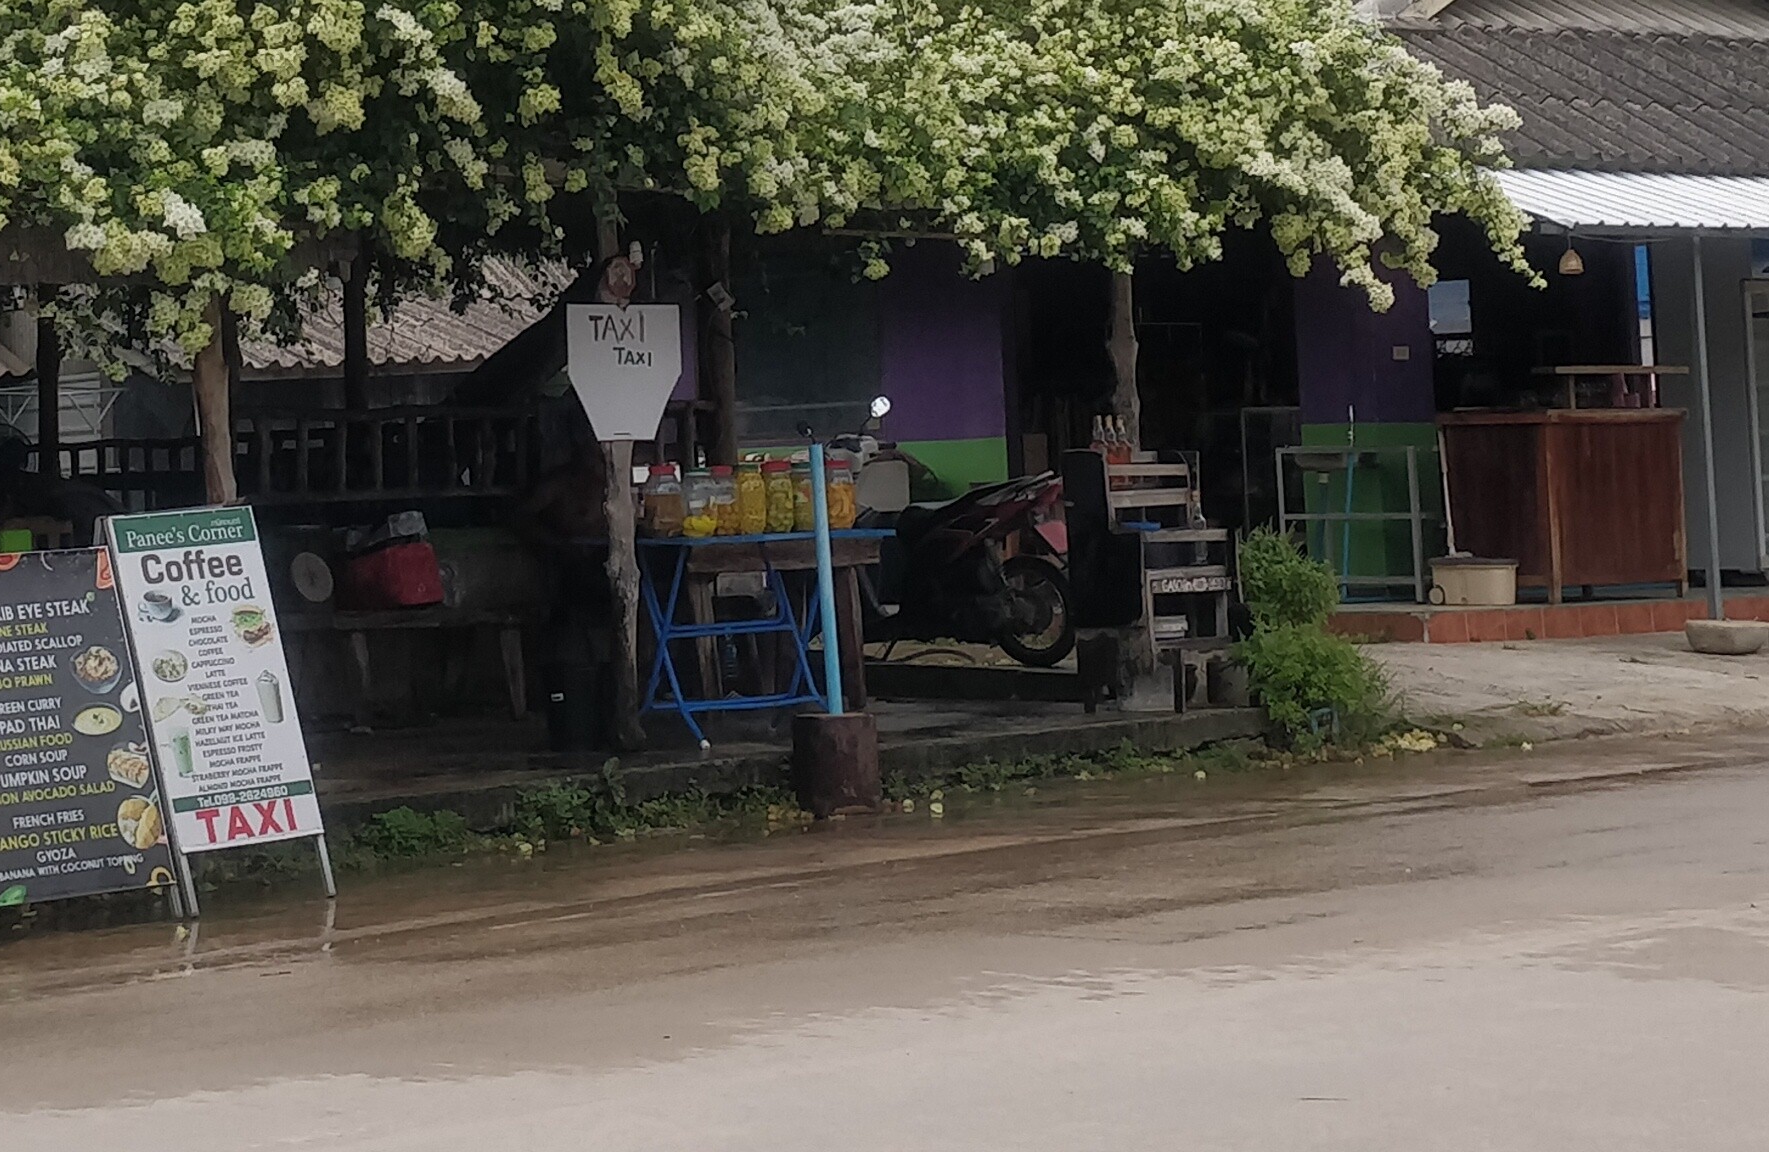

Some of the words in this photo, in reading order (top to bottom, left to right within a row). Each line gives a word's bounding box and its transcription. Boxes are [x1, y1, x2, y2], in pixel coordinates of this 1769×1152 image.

[588, 311, 645, 343] TAXI
[613, 347, 652, 367] TAXI
[125, 526, 185, 549] Panee's
[188, 524, 244, 542] Corner
[141, 549, 244, 584] Coffee
[182, 585, 200, 607] &
[205, 577, 255, 604] food
[18, 603, 42, 620] EYE
[47, 598, 90, 617] STEAK
[191, 615, 217, 624] MOCHA
[15, 622, 49, 636] STEAK
[189, 625, 223, 636] ESPRESSO
[34, 634, 83, 651] SCALLOP
[188, 635, 229, 647] CHOCOLATE
[198, 647, 224, 657] COFFEE
[18, 655, 57, 671] STEAK
[15, 673, 53, 688] PRAWN
[205, 669, 226, 679] LATTE
[222, 677, 248, 688] COFFEE
[202, 692, 225, 701] GREEN
[226, 690, 240, 698] TEA
[27, 697, 62, 712] CURRY
[225, 701, 238, 709] TEA
[28, 716, 61, 731] THAI
[192, 715, 214, 725] GREEN
[216, 713, 229, 722] TEA
[230, 710, 259, 720] MATCHA
[235, 721, 260, 731] MOCHA
[39, 732, 73, 747] FOOD
[245, 731, 266, 740] LATTE
[5, 753, 38, 767] CORN
[39, 749, 68, 764] SOUP
[202, 747, 236, 758] ESPRESSO
[209, 758, 235, 768] MOCHA
[236, 754, 261, 764] FRAPPE
[52, 765, 87, 782] SOUP
[232, 767, 258, 777] MOCHA
[258, 763, 283, 773] FRAPPE
[230, 778, 255, 788] MOCHA
[256, 774, 281, 784] FRAPPE
[22, 785, 76, 803] AVOCADO
[79, 780, 115, 795] SALAD
[12, 814, 55, 829] FRENCH
[57, 809, 85, 823] FRIES
[195, 798, 298, 844] TAXI
[44, 826, 86, 845] STICKY
[90, 823, 118, 839] RICE
[36, 848, 77, 863] GYOZA
[37, 863, 60, 876] WITH
[61, 859, 105, 874] COCONUT
